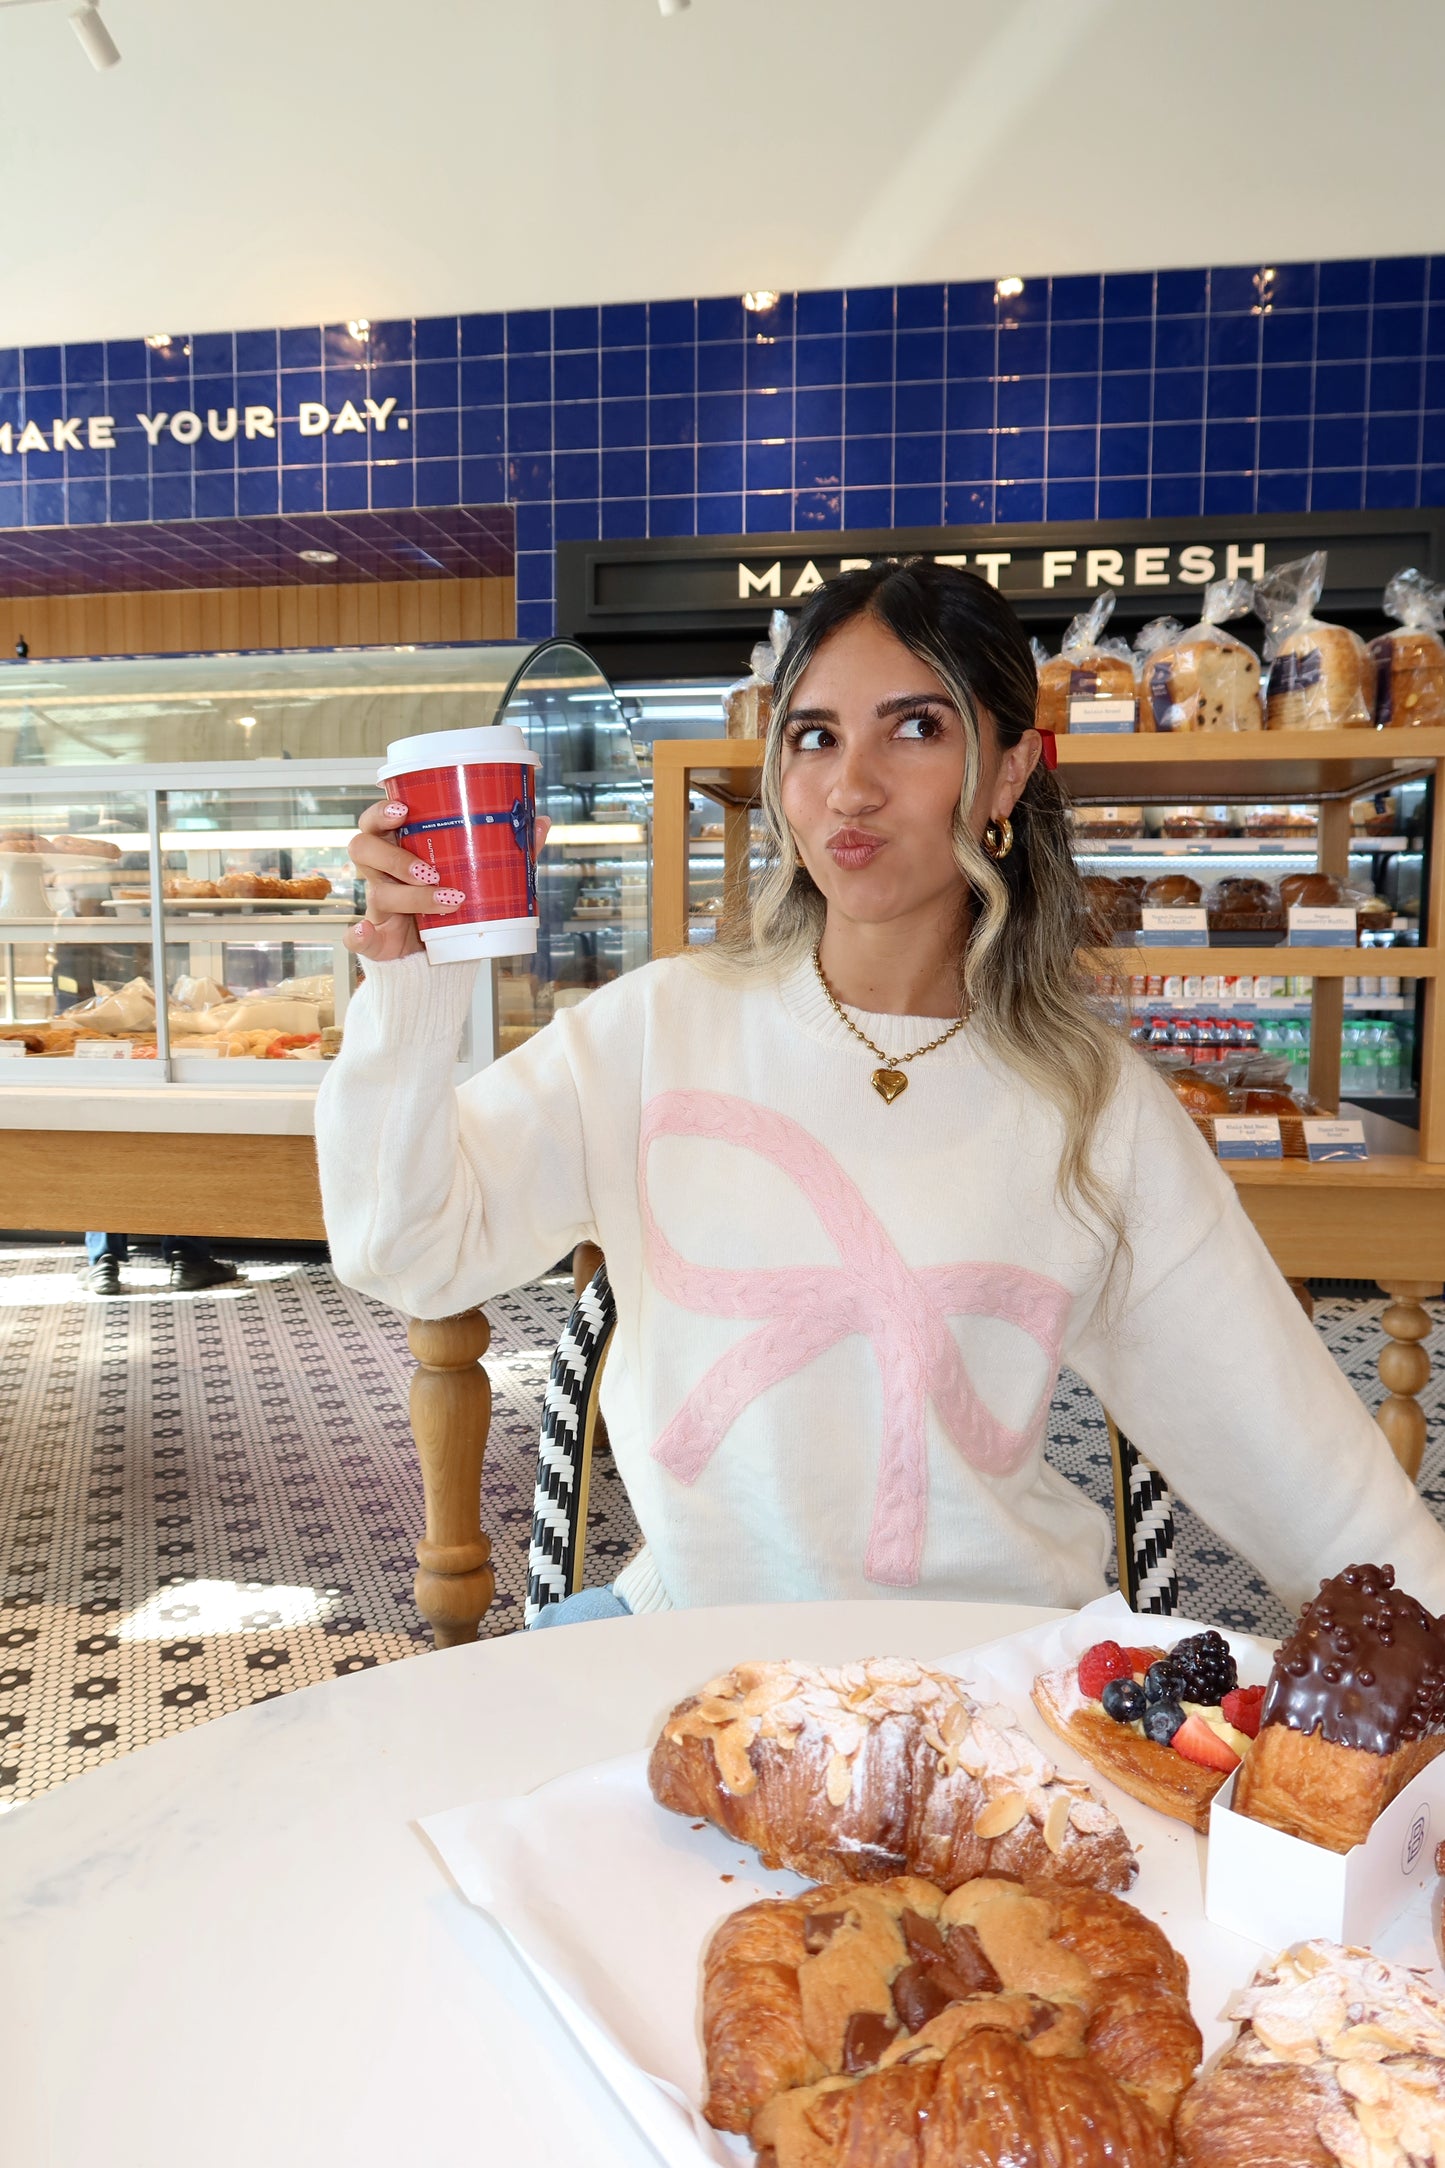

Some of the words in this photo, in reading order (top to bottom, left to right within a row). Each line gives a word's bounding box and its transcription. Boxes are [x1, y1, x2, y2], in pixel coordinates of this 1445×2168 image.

[137, 405, 276, 445] YOUR
[298, 397, 409, 437] DAY.
[738, 553, 1011, 599] MAT
[1042, 543, 1266, 588] FRESH
